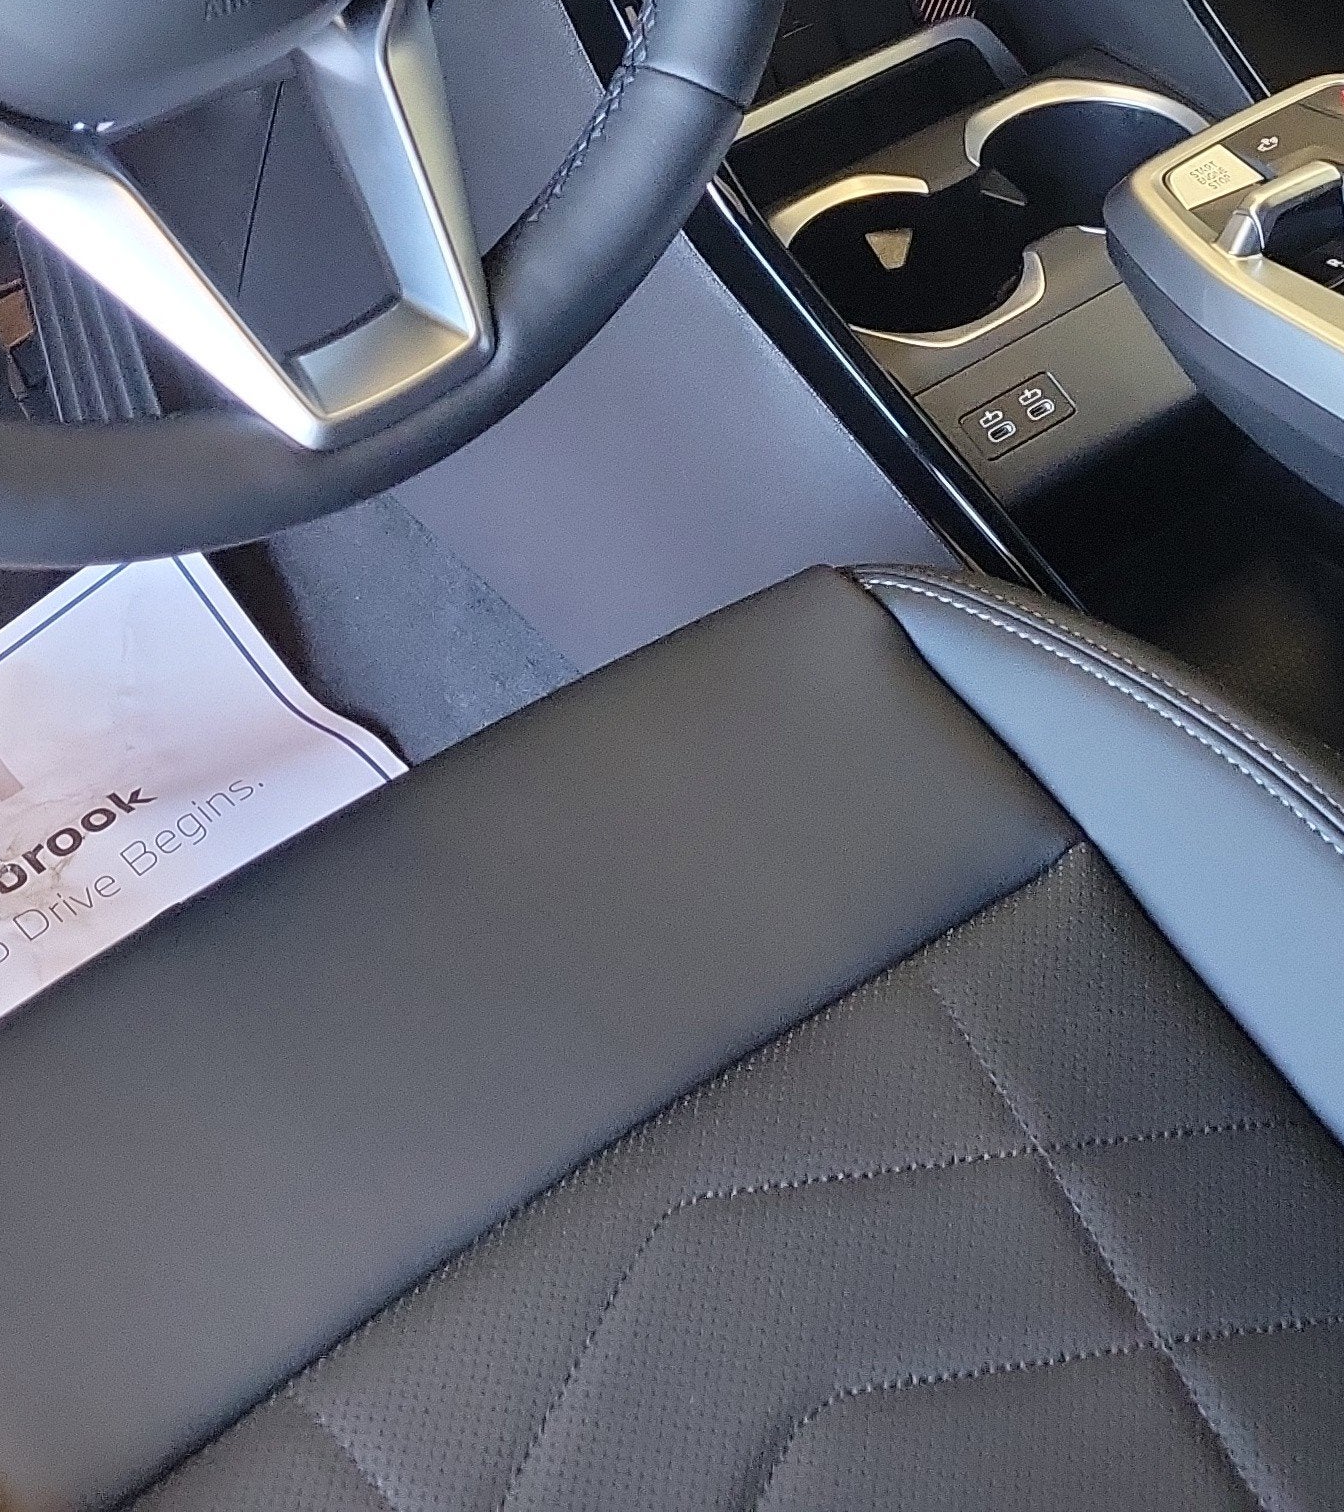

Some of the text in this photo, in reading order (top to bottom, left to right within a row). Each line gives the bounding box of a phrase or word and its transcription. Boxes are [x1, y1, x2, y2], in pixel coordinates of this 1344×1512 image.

[1189, 160, 1217, 180] START
[1208, 174, 1231, 189] STOP
[12, 871, 121, 941] Drive
[120, 778, 267, 877] Begins.
